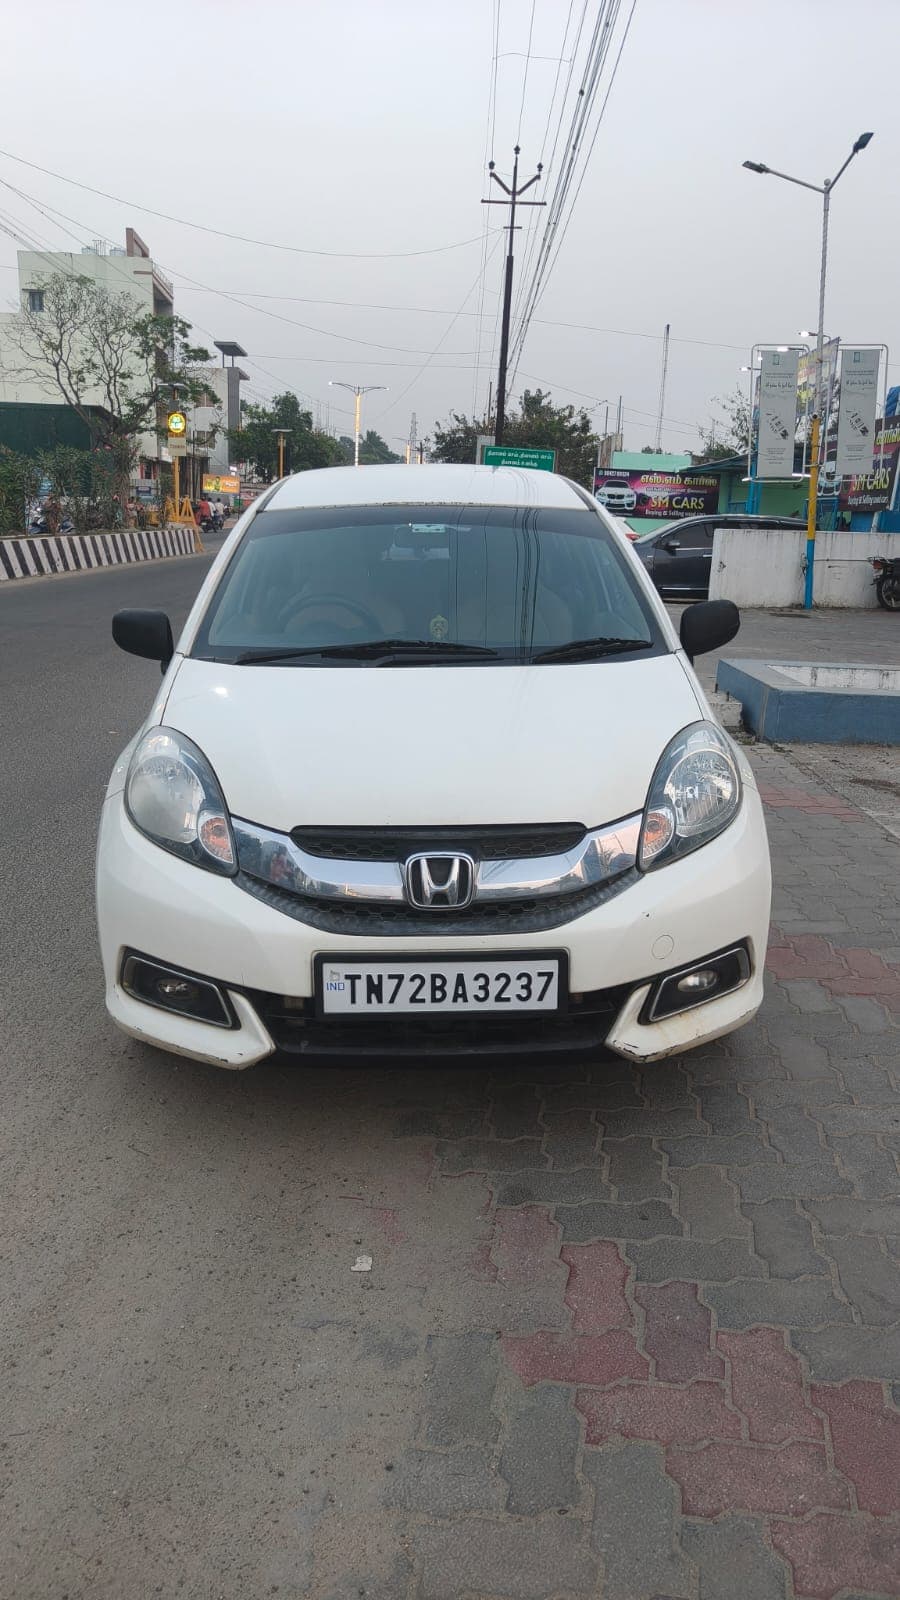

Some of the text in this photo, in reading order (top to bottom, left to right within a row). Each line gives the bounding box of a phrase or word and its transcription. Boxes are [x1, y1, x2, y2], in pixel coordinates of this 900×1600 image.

[866, 467, 892, 490] CARS
[651, 496, 705, 510] SM CARS
[344, 971, 555, 1005] TN72BA3237
